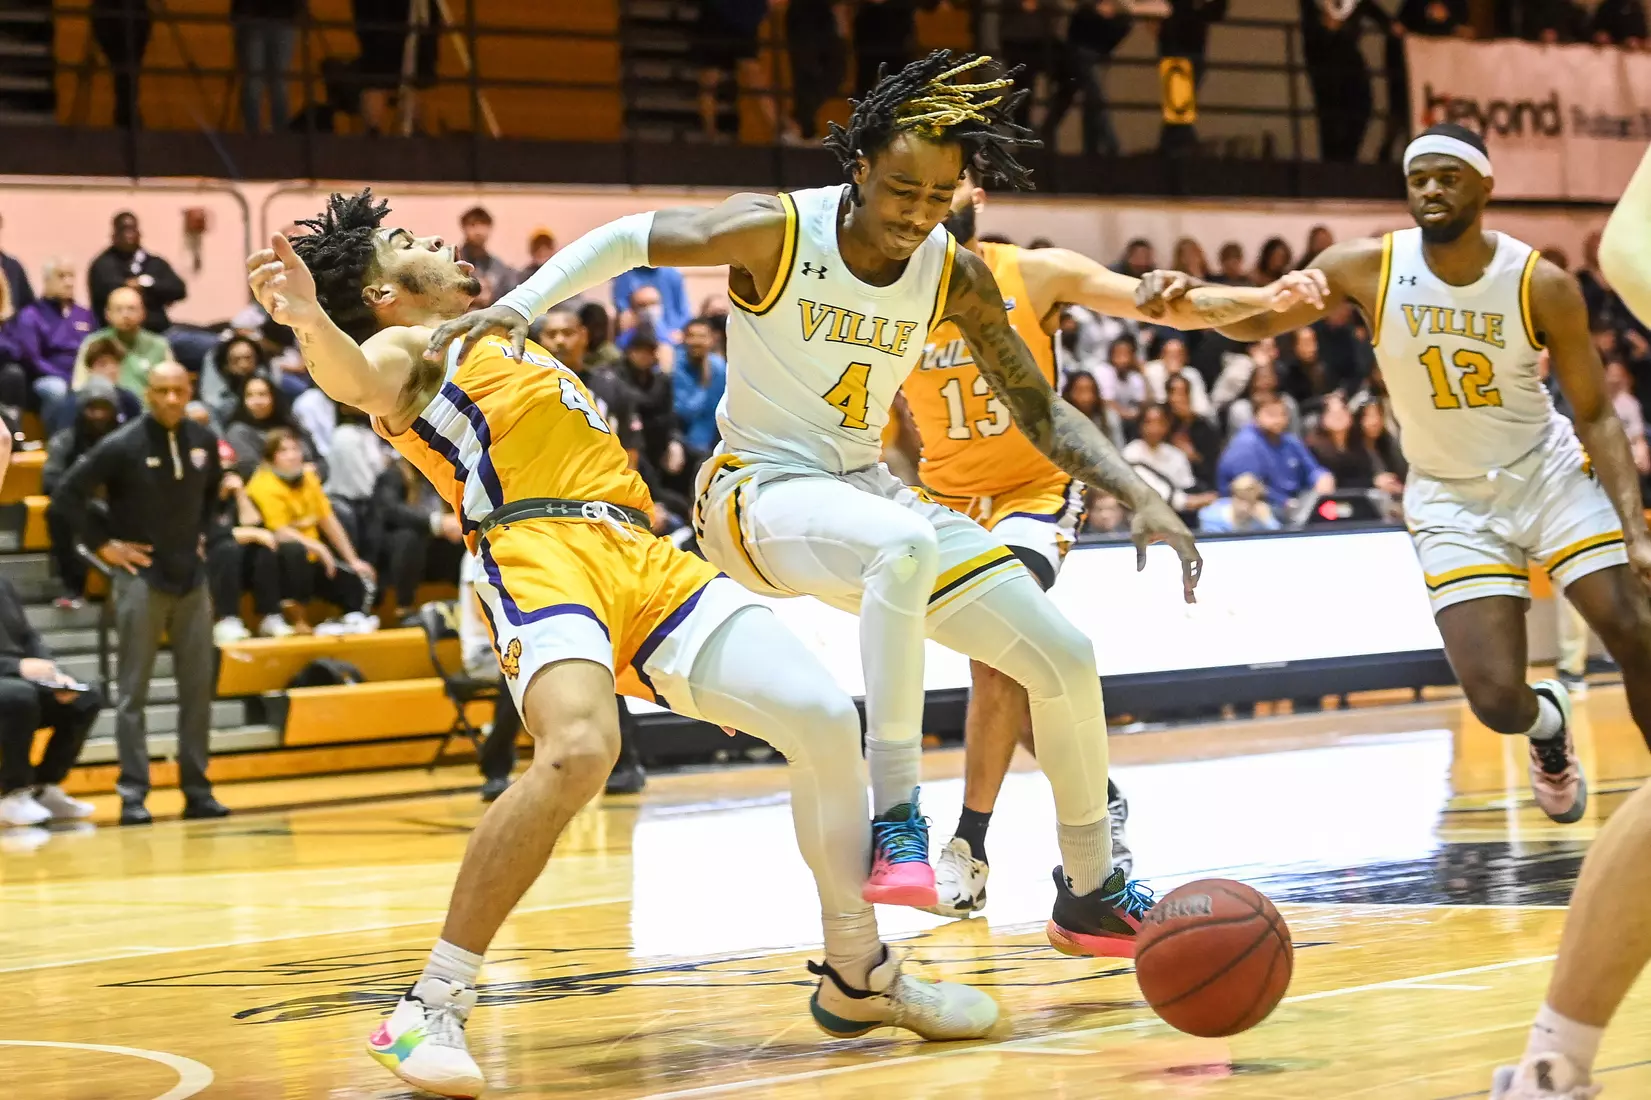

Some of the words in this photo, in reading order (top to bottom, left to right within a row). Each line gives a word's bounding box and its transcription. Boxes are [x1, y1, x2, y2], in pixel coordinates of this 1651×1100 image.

[798, 298, 918, 357] VILLE
[1400, 303, 1506, 349] VILLE
[557, 377, 612, 435] 4
[821, 361, 872, 430] 4
[938, 373, 1012, 441] 13
[1418, 345, 1503, 410] 12
